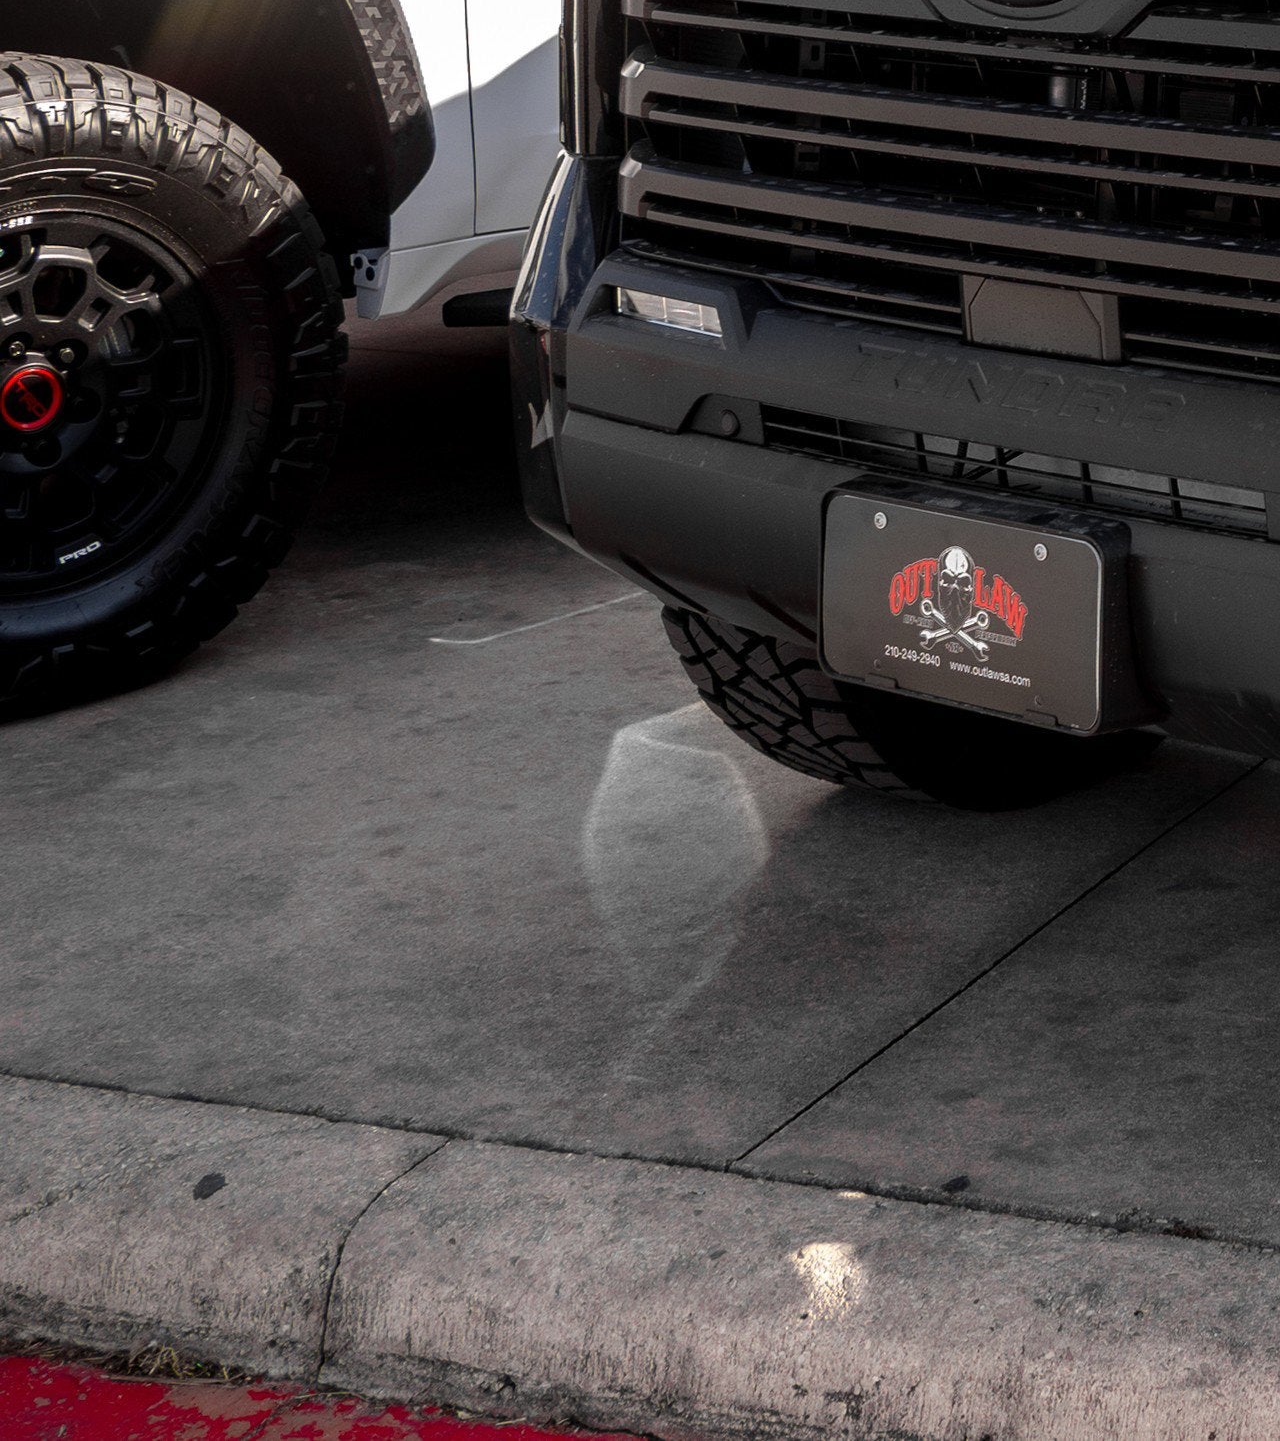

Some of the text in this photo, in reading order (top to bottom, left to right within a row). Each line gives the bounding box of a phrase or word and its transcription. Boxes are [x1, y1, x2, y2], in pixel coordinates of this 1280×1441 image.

[853, 342, 1187, 434] TUNDRA
[58, 541, 103, 565] PRO
[949, 660, 1032, 688] www.outlawsa.com
